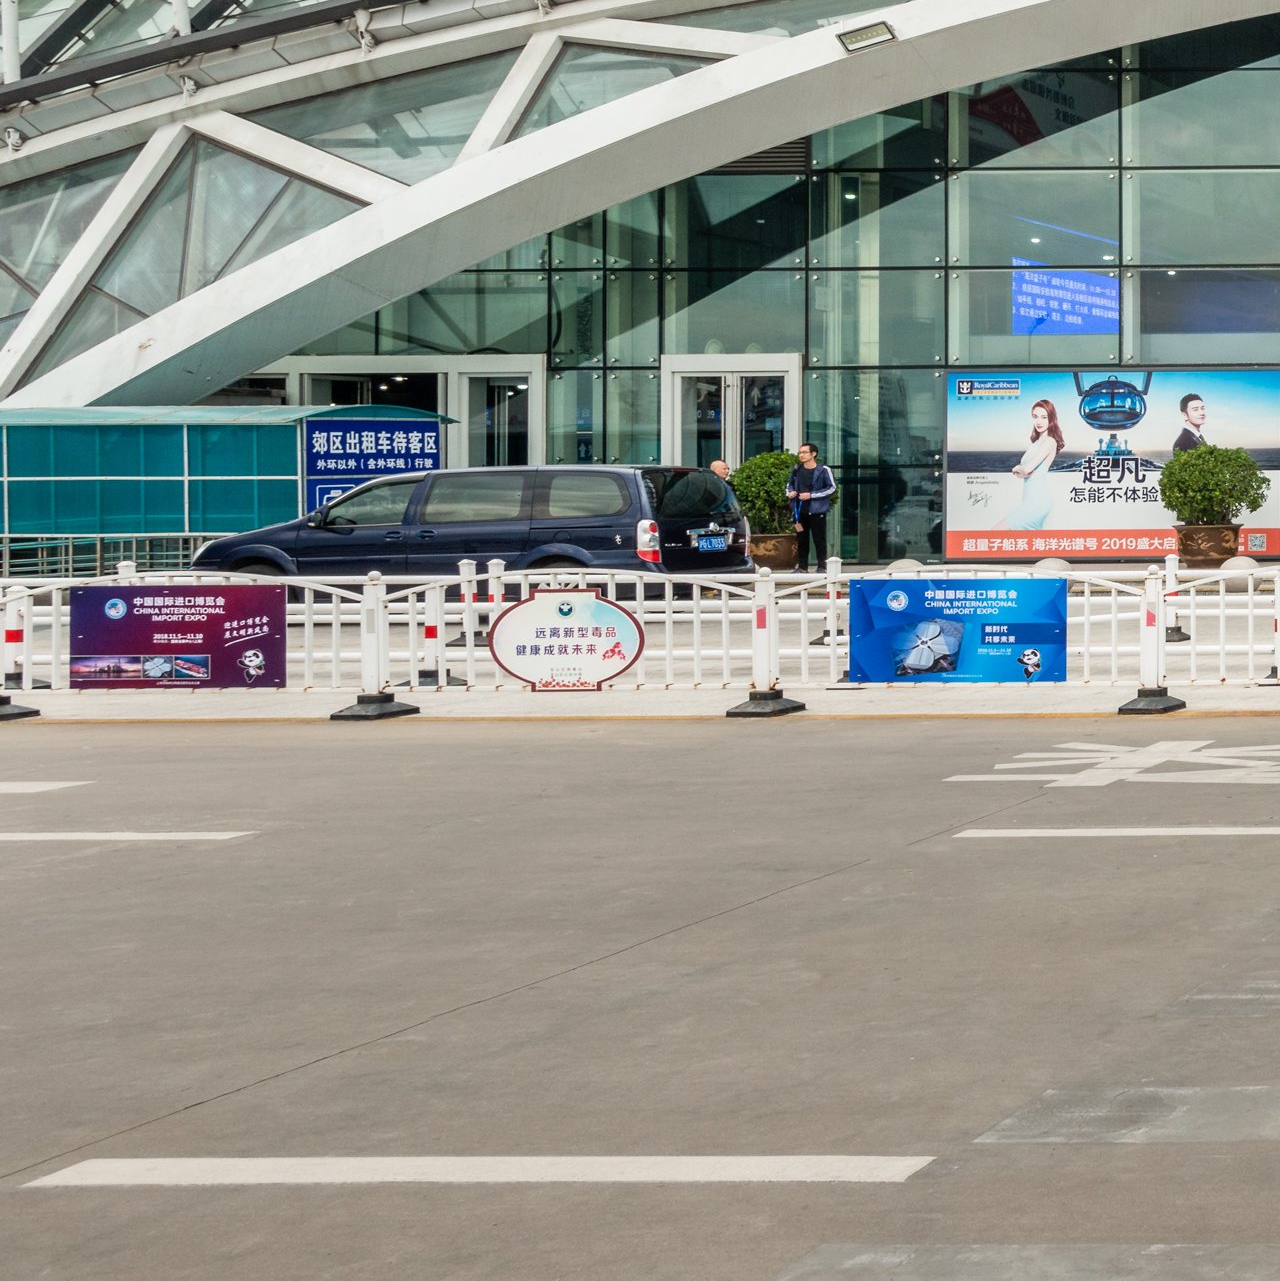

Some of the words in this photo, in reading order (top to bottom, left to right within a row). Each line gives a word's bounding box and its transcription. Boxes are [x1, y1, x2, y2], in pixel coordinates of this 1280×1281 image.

[312, 431, 437, 454] 郊区出租车待客区
[1083, 456, 1146, 484] 超凡
[1070, 487, 1159, 503] 怎能不体验
[962, 538, 1028, 551] 超量子船系
[1032, 538, 1098, 551] 海洋光谱号
[1101, 537, 1177, 550] 2019盛大启
[925, 590, 1018, 599] 中国国际进口博览会
[133, 597, 225, 606] 中国国际进口博览会
[535, 627, 617, 639] 远离新型毒品
[516, 644, 597, 656] 健康成就未来
